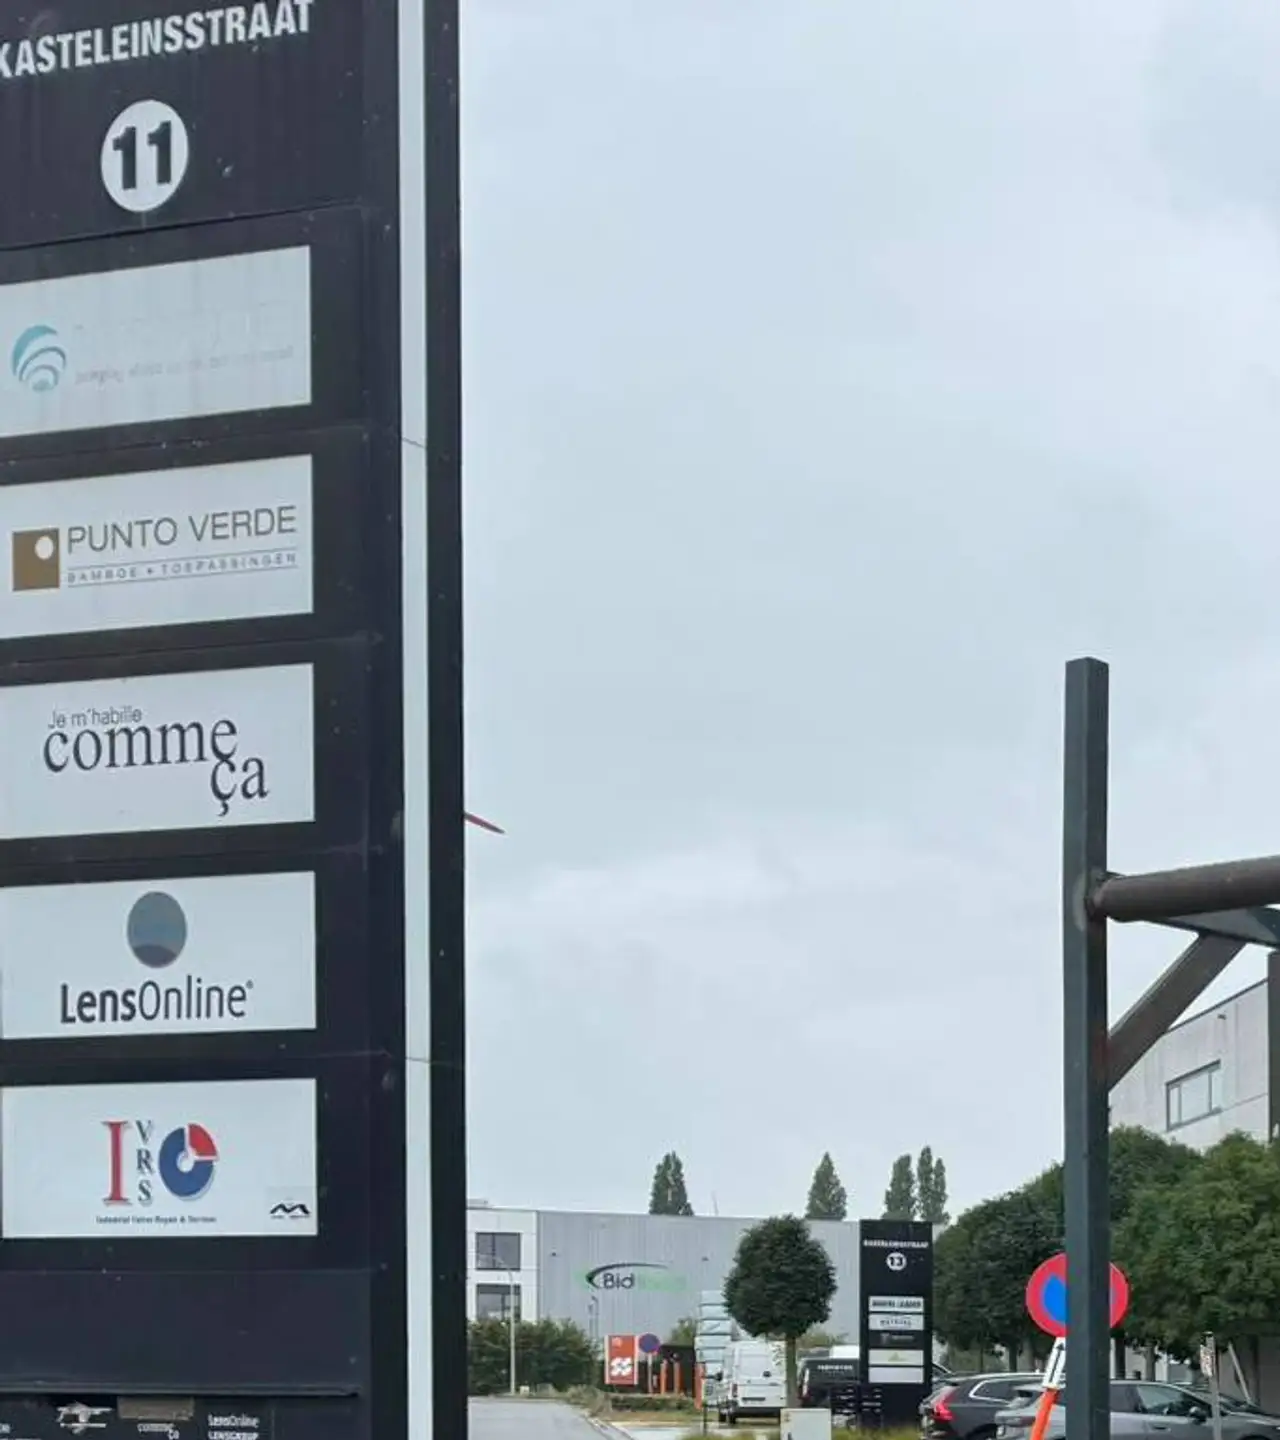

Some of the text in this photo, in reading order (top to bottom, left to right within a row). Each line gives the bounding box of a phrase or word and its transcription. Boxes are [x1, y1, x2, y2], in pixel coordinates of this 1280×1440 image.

[0, 0, 313, 78] KASTELEINSSTRAAT
[111, 119, 173, 192] 11
[67, 504, 297, 554] PUNTO VERDE
[67, 566, 138, 584] BAMBOE
[43, 719, 238, 774] comme
[48, 710, 66, 730] Je
[210, 756, 271, 817] ça
